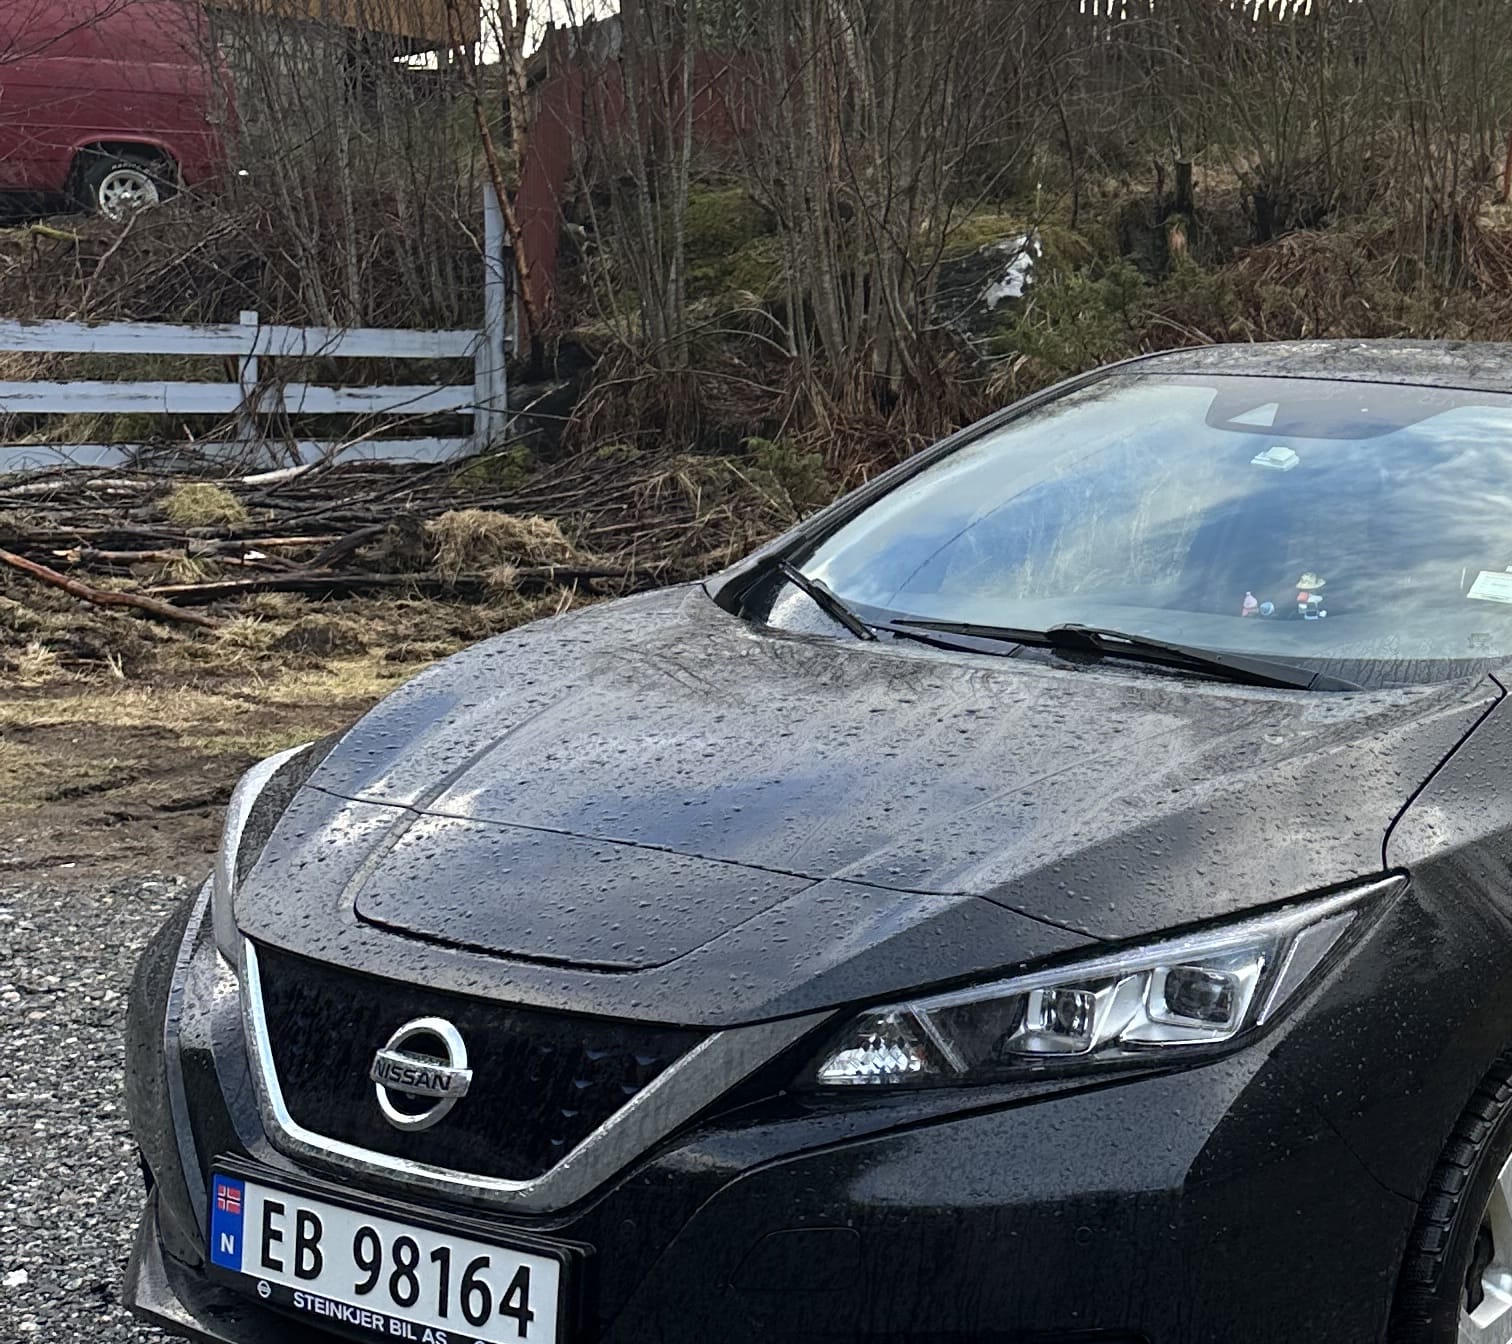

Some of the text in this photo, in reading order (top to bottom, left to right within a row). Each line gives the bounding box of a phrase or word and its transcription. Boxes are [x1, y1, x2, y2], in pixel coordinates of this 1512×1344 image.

[373, 1059, 452, 1091] NISSAN
[220, 1232, 234, 1255] N
[260, 1198, 535, 1338] EB 98164
[293, 1291, 384, 1332] STEINKJER
[389, 1318, 418, 1341] BIL
